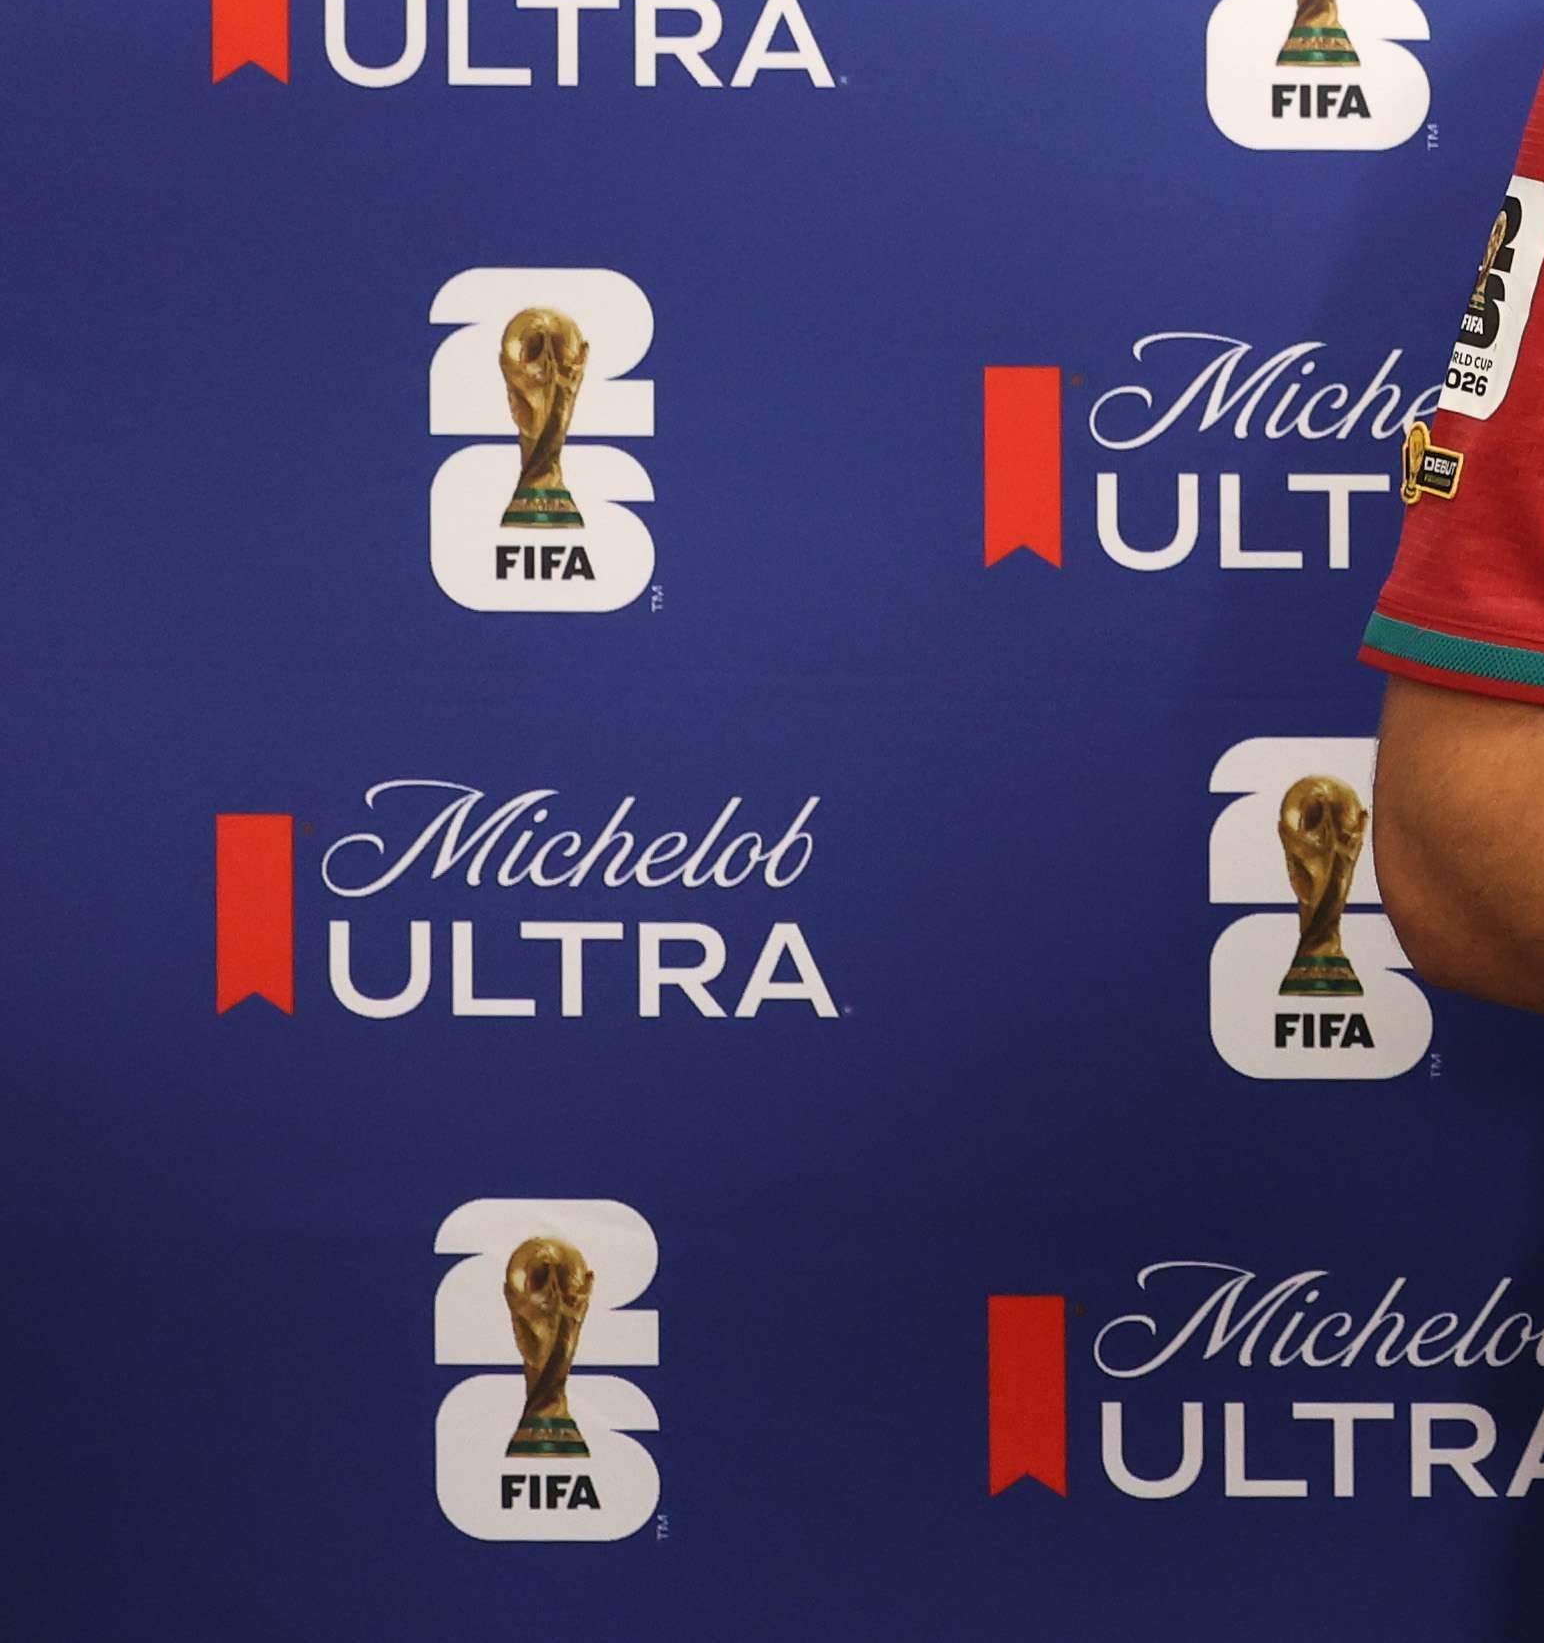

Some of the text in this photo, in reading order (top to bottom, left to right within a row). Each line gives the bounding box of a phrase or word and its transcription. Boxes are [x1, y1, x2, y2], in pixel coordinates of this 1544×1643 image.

[1272, 85, 1370, 118] FIFA
[1461, 313, 1484, 335] FIFA
[1474, 356, 1493, 372] CUP
[1424, 456, 1457, 476] DEBUT
[496, 546, 595, 580] FIFA
[322, 780, 819, 897] Michelob
[329, 921, 838, 1018] ULTRA
[1275, 1014, 1374, 1048] FIFA
[502, 1475, 600, 1509] FIFA
